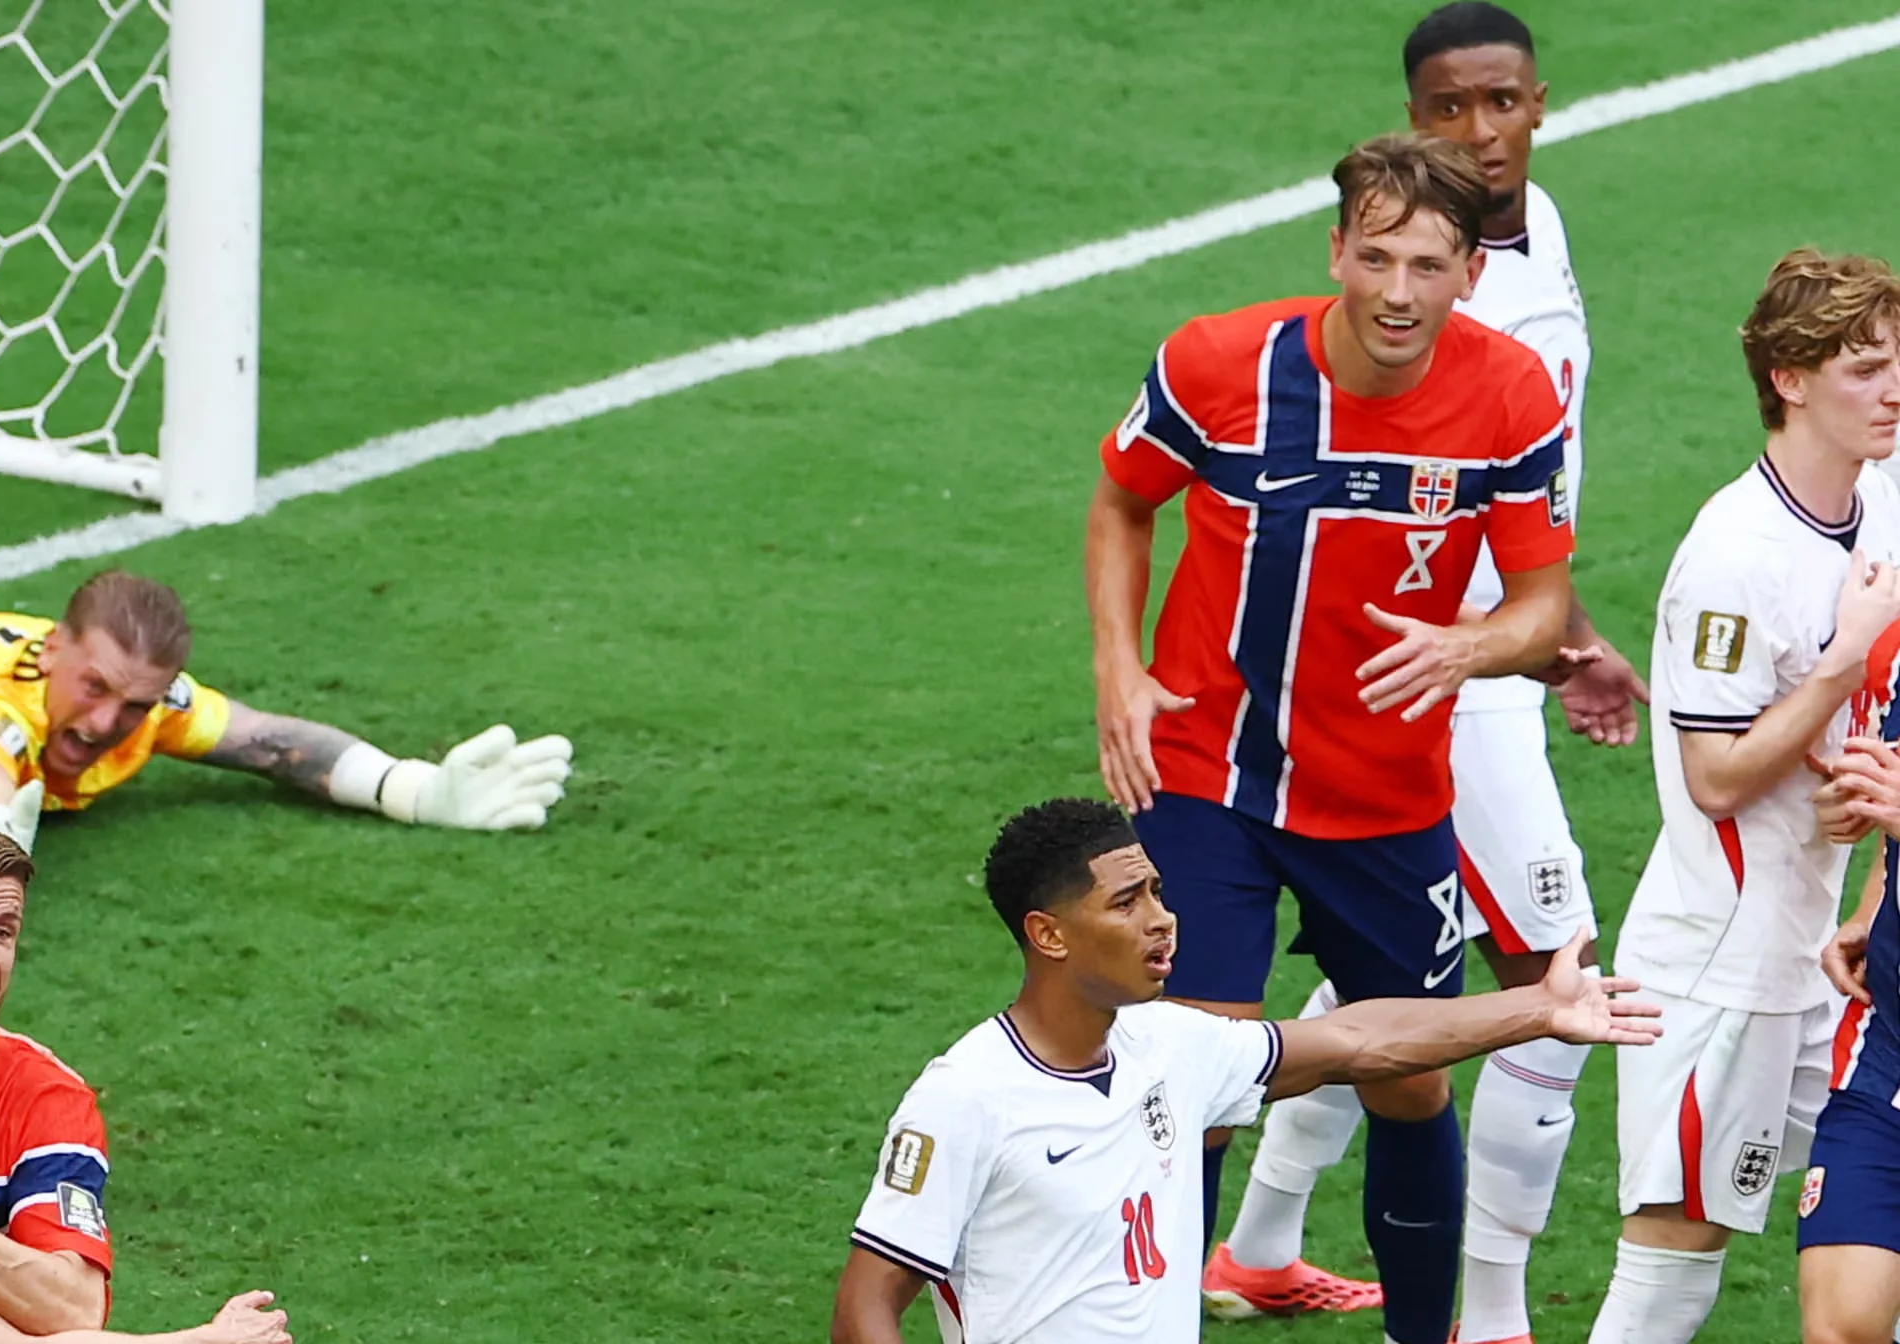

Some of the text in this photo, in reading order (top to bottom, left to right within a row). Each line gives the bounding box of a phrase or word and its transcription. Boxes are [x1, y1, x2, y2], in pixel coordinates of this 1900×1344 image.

[1394, 530, 1447, 595] 8
[1428, 870, 1462, 956] 8
[1121, 1192, 1166, 1285] 10
